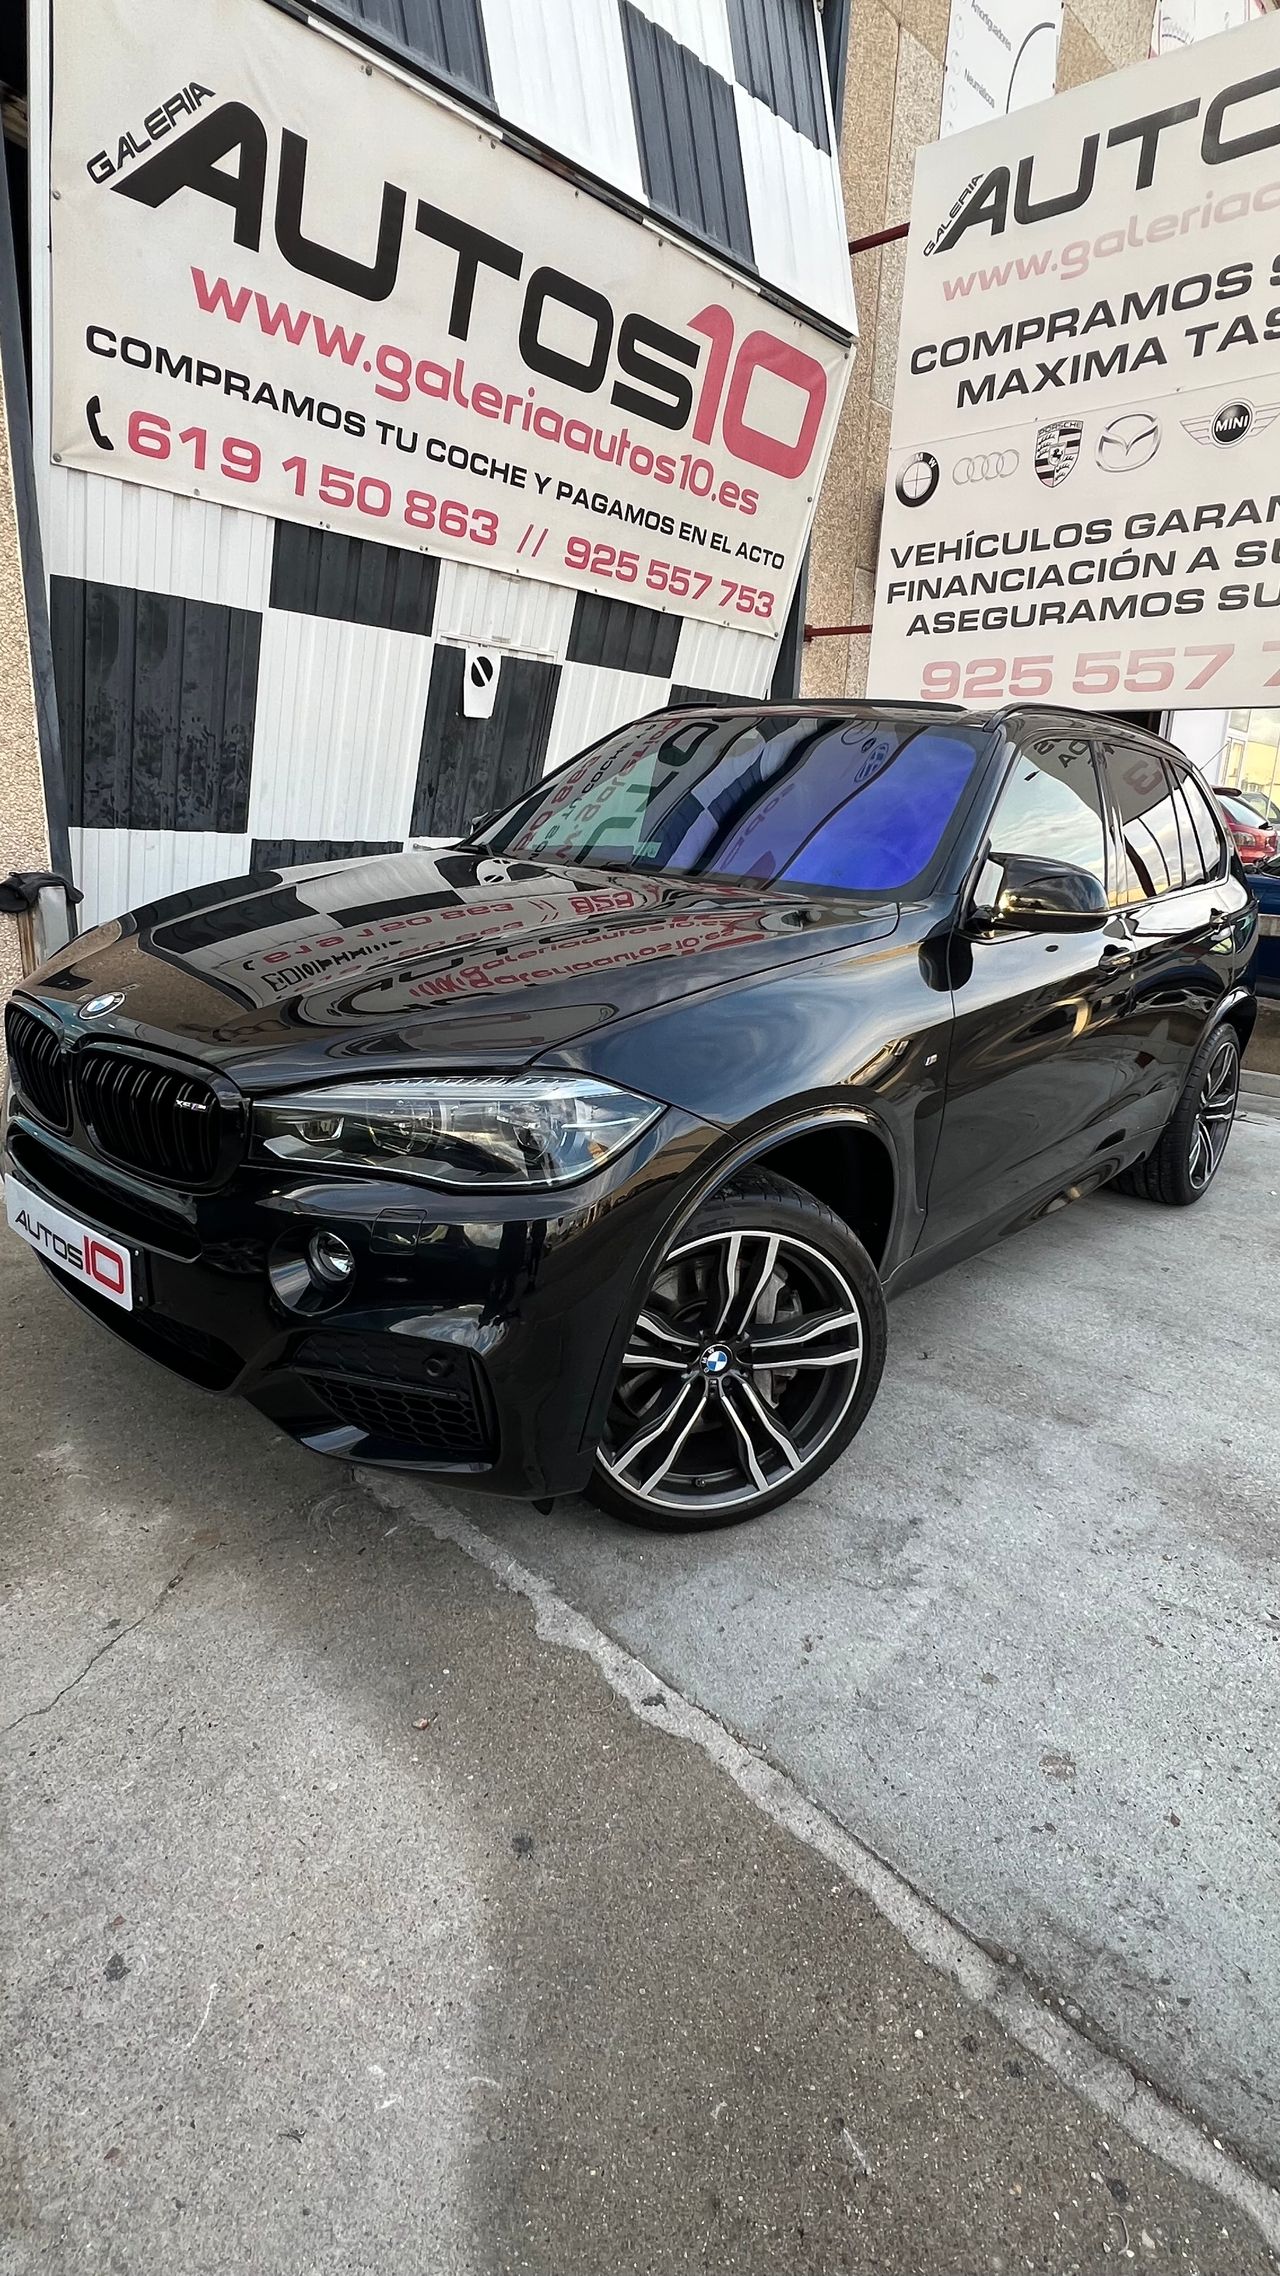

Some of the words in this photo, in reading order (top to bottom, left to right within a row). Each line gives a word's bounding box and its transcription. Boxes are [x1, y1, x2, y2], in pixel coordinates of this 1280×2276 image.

[87, 82, 216, 185] GALERIA
[923, 172, 985, 257] GALERIA
[110, 102, 828, 480] AUTOS10
[910, 262, 1254, 375] COMPRAMOS
[191, 267, 760, 516] www.galeriaautos10.es
[957, 336, 1168, 409] MAXIMA
[86, 325, 366, 438] COMPRAMOS
[375, 419, 419, 454] TU
[427, 438, 528, 490] COCHE
[534, 472, 553, 495] Y
[556, 480, 675, 536] PAGAMOS
[678, 521, 708, 546] EN
[710, 532, 732, 555] EL
[735, 541, 785, 570] ACTO
[1215, 414, 1249, 432] MINI
[128, 410, 261, 483] 619
[282, 455, 391, 518] 150
[404, 489, 499, 546] 863
[564, 536, 640, 583] 925
[646, 559, 713, 600] 557
[719, 579, 775, 618] 753
[890, 518, 1113, 568] VEHÍCULOS
[887, 547, 1176, 604] FINANCIACIÓN
[1185, 546, 1220, 574] A
[1234, 537, 1280, 568] S
[906, 588, 1205, 637] ASEGURAMOS
[920, 655, 1054, 700] 925
[1072, 644, 1235, 694] 557
[15, 1209, 125, 1295] AUTOS10
